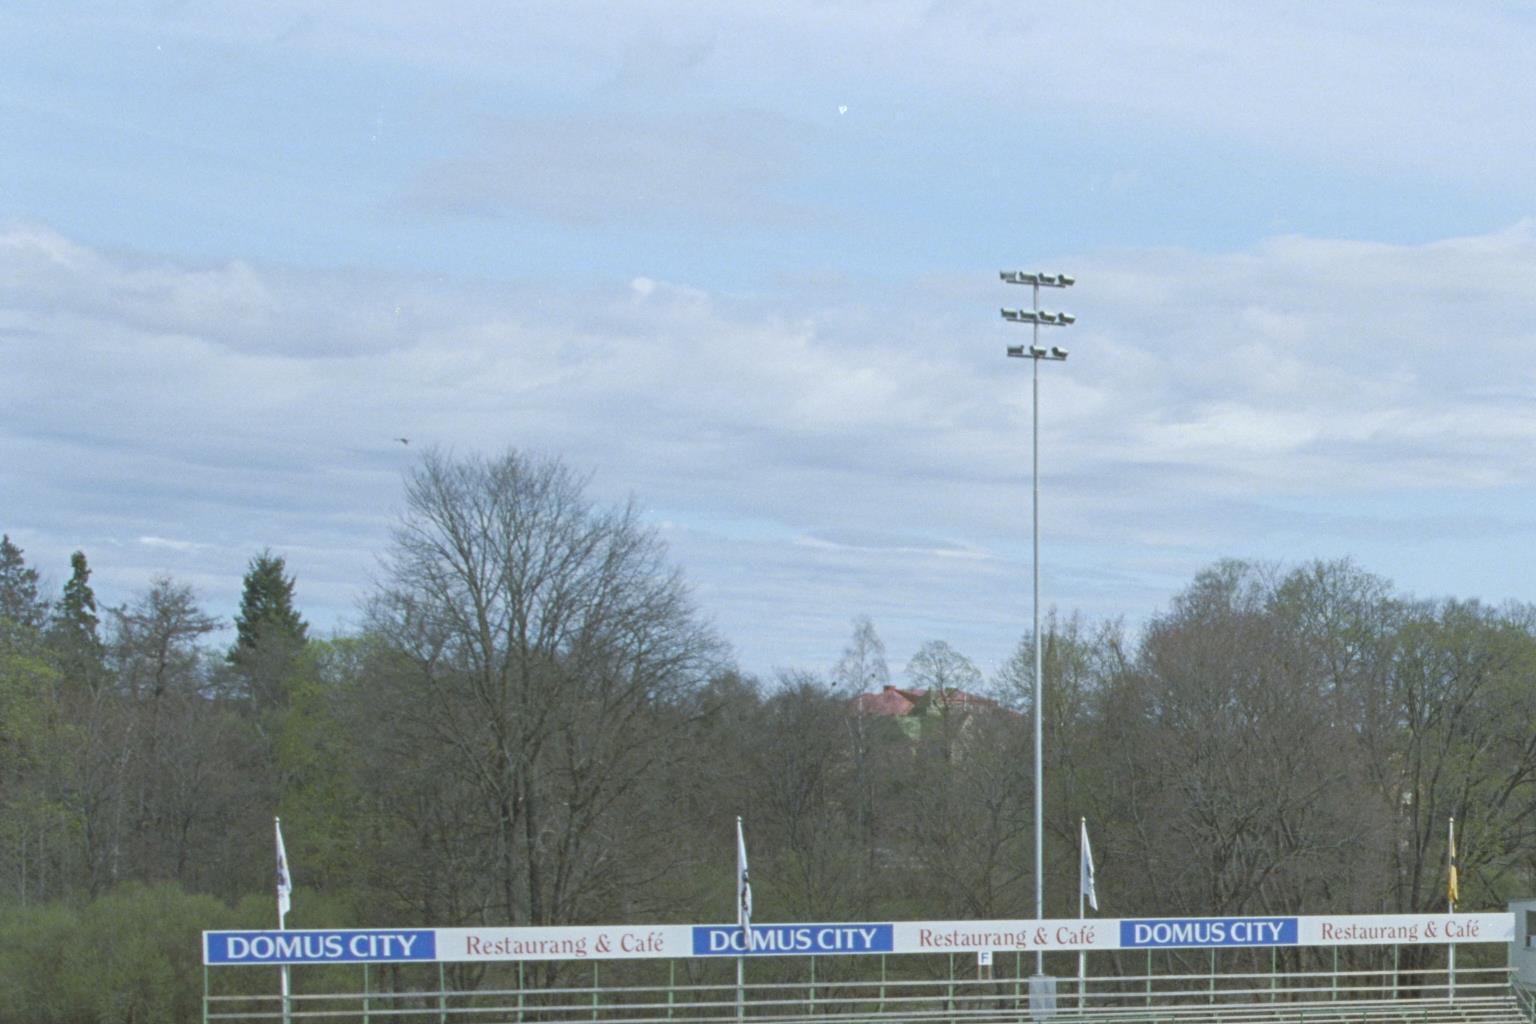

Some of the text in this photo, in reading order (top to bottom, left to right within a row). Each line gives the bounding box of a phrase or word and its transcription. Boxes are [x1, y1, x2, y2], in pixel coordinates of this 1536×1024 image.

[709, 928, 878, 952] DOMUS CITY
[919, 925, 1095, 948] Restaurang & Café
[1134, 921, 1284, 944] DOMUS CITY
[1321, 919, 1480, 942] Restaurang & Café
[226, 934, 417, 959] DOMUS CITY
[466, 931, 664, 957] Restaurang & Café
[981, 951, 989, 963] F
